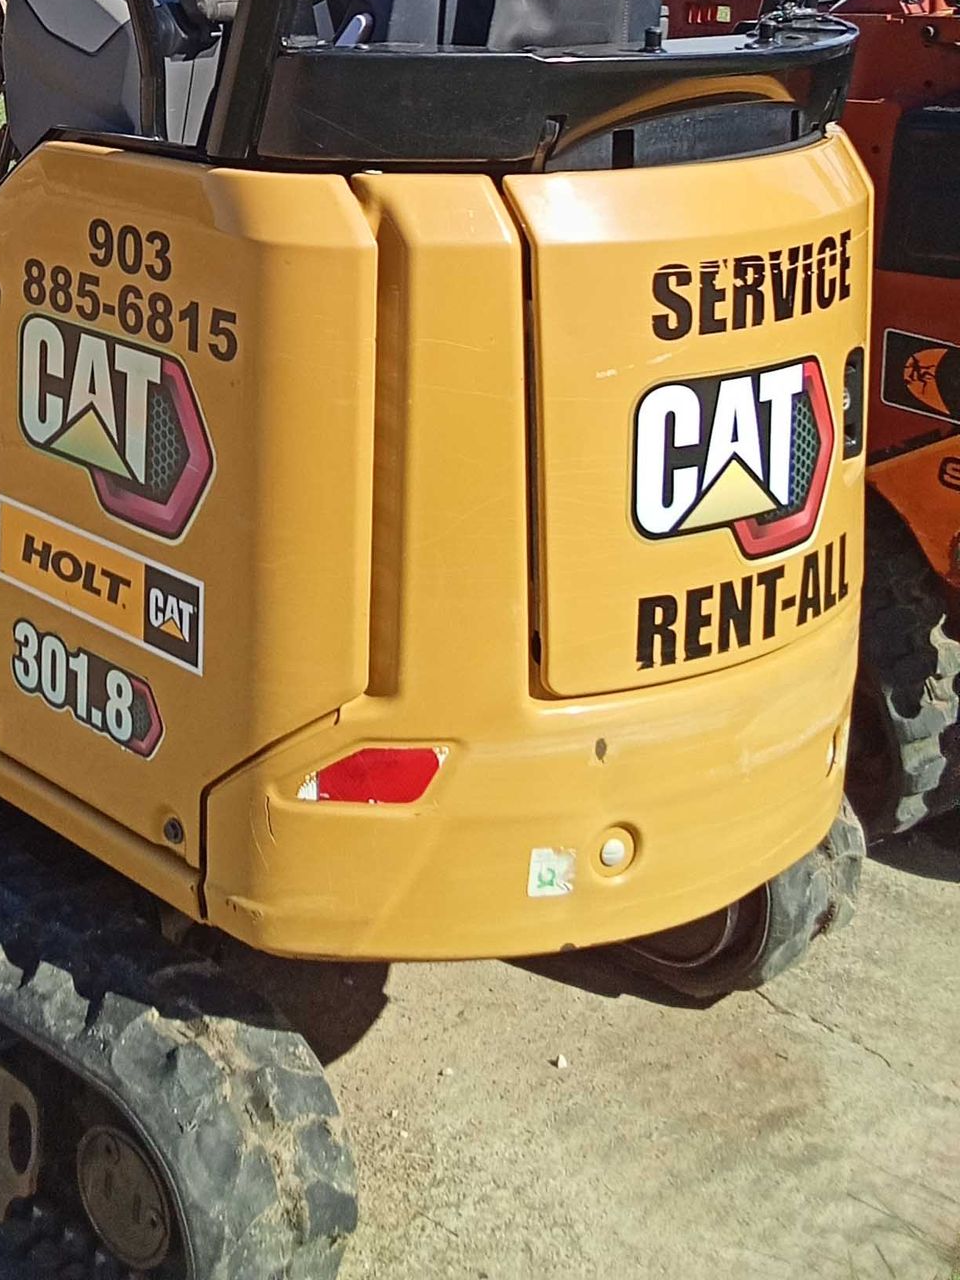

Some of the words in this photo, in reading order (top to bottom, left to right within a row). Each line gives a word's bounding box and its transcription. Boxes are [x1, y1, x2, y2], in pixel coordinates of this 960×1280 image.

[89, 218, 172, 282] 903
[651, 229, 852, 341] SERVICE
[22, 258, 238, 362] 885-6815
[22, 317, 161, 485] CAT
[635, 363, 803, 533] CAT
[149, 588, 194, 643] CAT
[636, 533, 849, 671] RENT-ALL
[13, 622, 134, 742] 301.8
